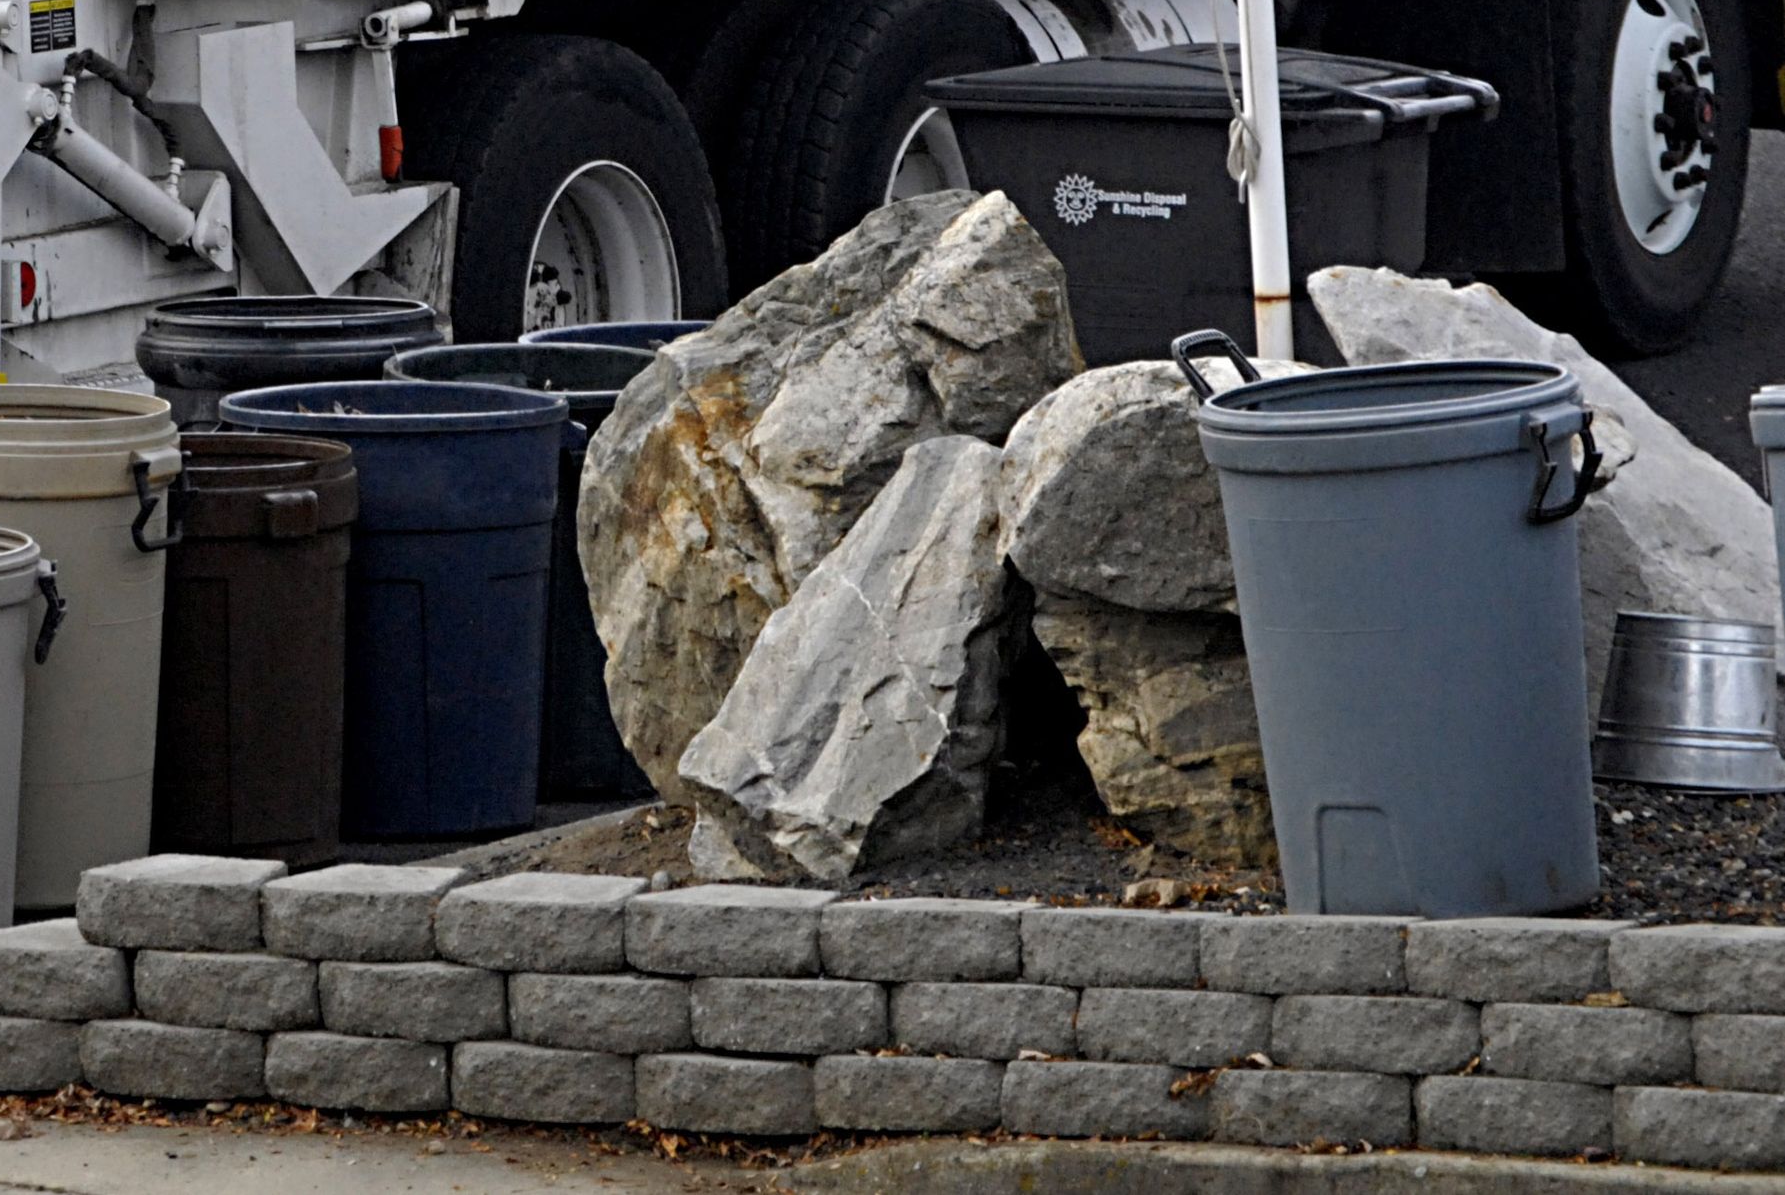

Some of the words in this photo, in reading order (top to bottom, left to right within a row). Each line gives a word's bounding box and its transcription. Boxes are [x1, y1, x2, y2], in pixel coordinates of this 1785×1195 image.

[1097, 189, 1142, 203] Sunshine
[1143, 191, 1187, 206] Disposal
[1122, 203, 1171, 219] Recycling
